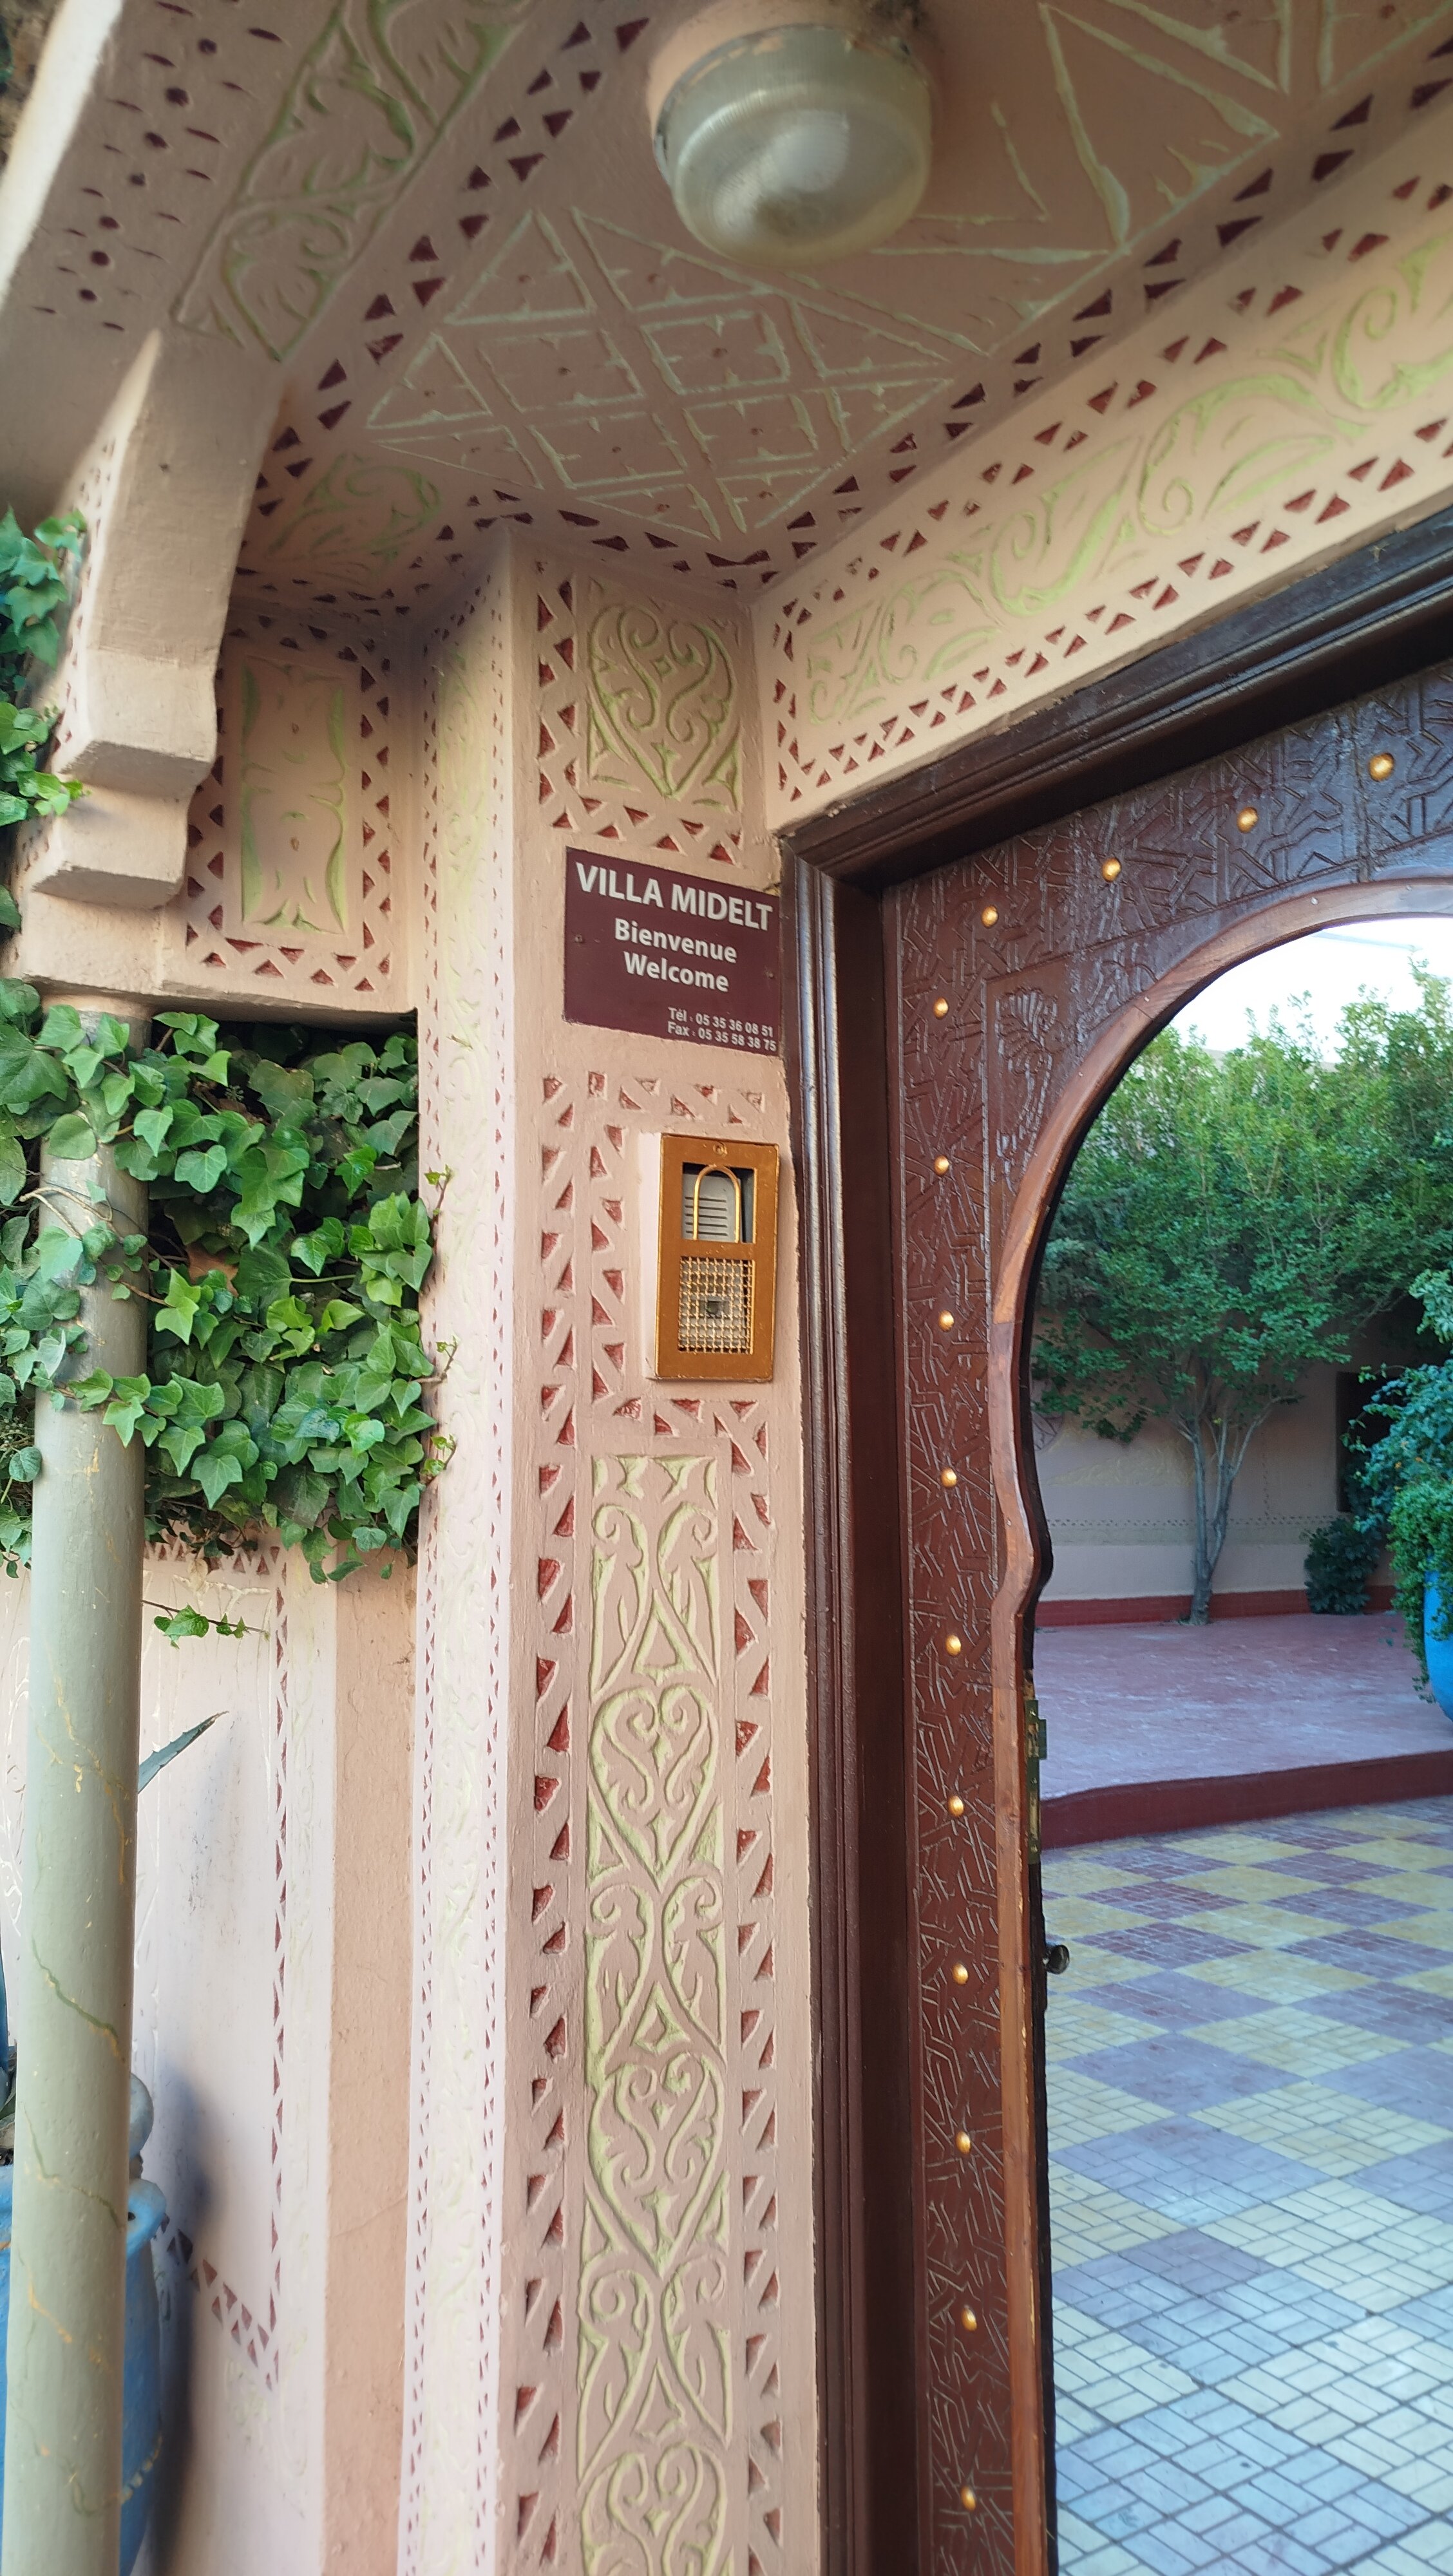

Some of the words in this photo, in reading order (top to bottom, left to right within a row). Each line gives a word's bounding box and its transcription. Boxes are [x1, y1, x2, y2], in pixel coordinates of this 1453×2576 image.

[576, 862, 665, 908] VILLA
[670, 884, 773, 931] MIDELT
[614, 918, 737, 963] Bienvenue
[623, 951, 729, 992] Welcome
[667, 1021, 690, 1037] Fax
[698, 1027, 712, 1041] 05
[715, 1030, 729, 1043] 35
[732, 1033, 745, 1046] 58
[747, 1036, 761, 1049] 38
[763, 1039, 777, 1052] 75
[668, 1007, 687, 1022] Tél
[696, 1013, 710, 1026] 05
[712, 1016, 726, 1029] 35
[728, 1019, 743, 1032] 36
[745, 1021, 759, 1035] 08
[761, 1025, 773, 1037] 51
